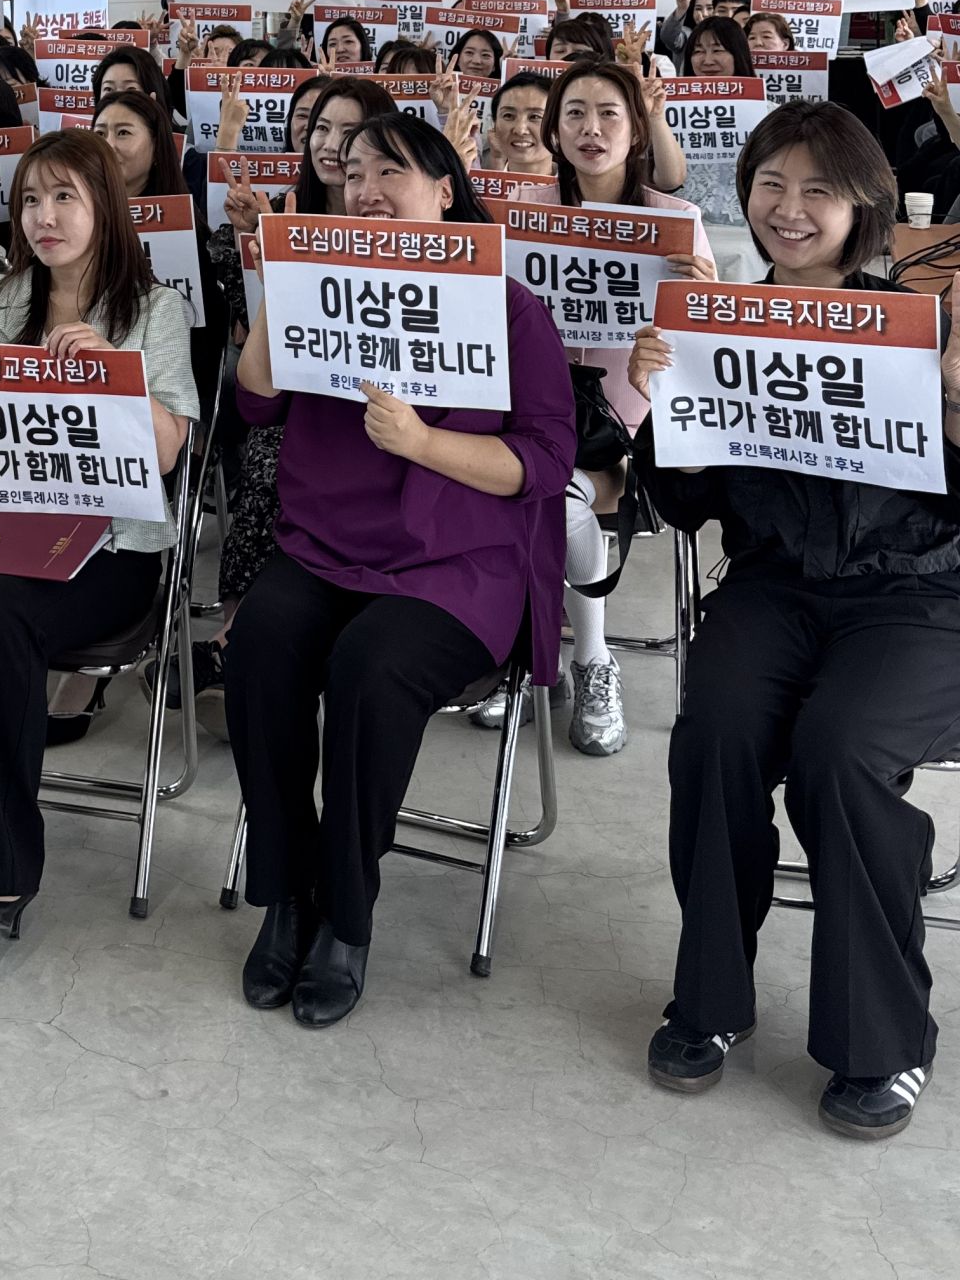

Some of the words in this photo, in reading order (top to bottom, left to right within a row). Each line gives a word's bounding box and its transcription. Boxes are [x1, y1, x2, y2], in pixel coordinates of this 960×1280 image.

[664, 80, 744, 97] 정교육지원가
[242, 125, 268, 142] 함께
[664, 105, 736, 129] 이상일
[688, 131, 717, 149] 함께
[287, 225, 475, 262] 진심이담긴행정가
[508, 208, 659, 245] 미래교육전문가
[525, 251, 640, 298] 이상일
[320, 275, 441, 334] 이상일
[560, 297, 608, 325] 함께
[685, 291, 886, 332] 열정교육지원가
[284, 324, 352, 365] 우리가
[356, 332, 401, 372] 함께
[407, 338, 496, 377] 합니다
[713, 347, 866, 409] 이상일
[670, 395, 757, 434] 우리가
[762, 403, 824, 445] 함께
[830, 412, 929, 458] 합니다
[24, 449, 73, 483] 함께
[76, 453, 149, 489] 합니다
[728, 440, 818, 467] 용인특례시장
